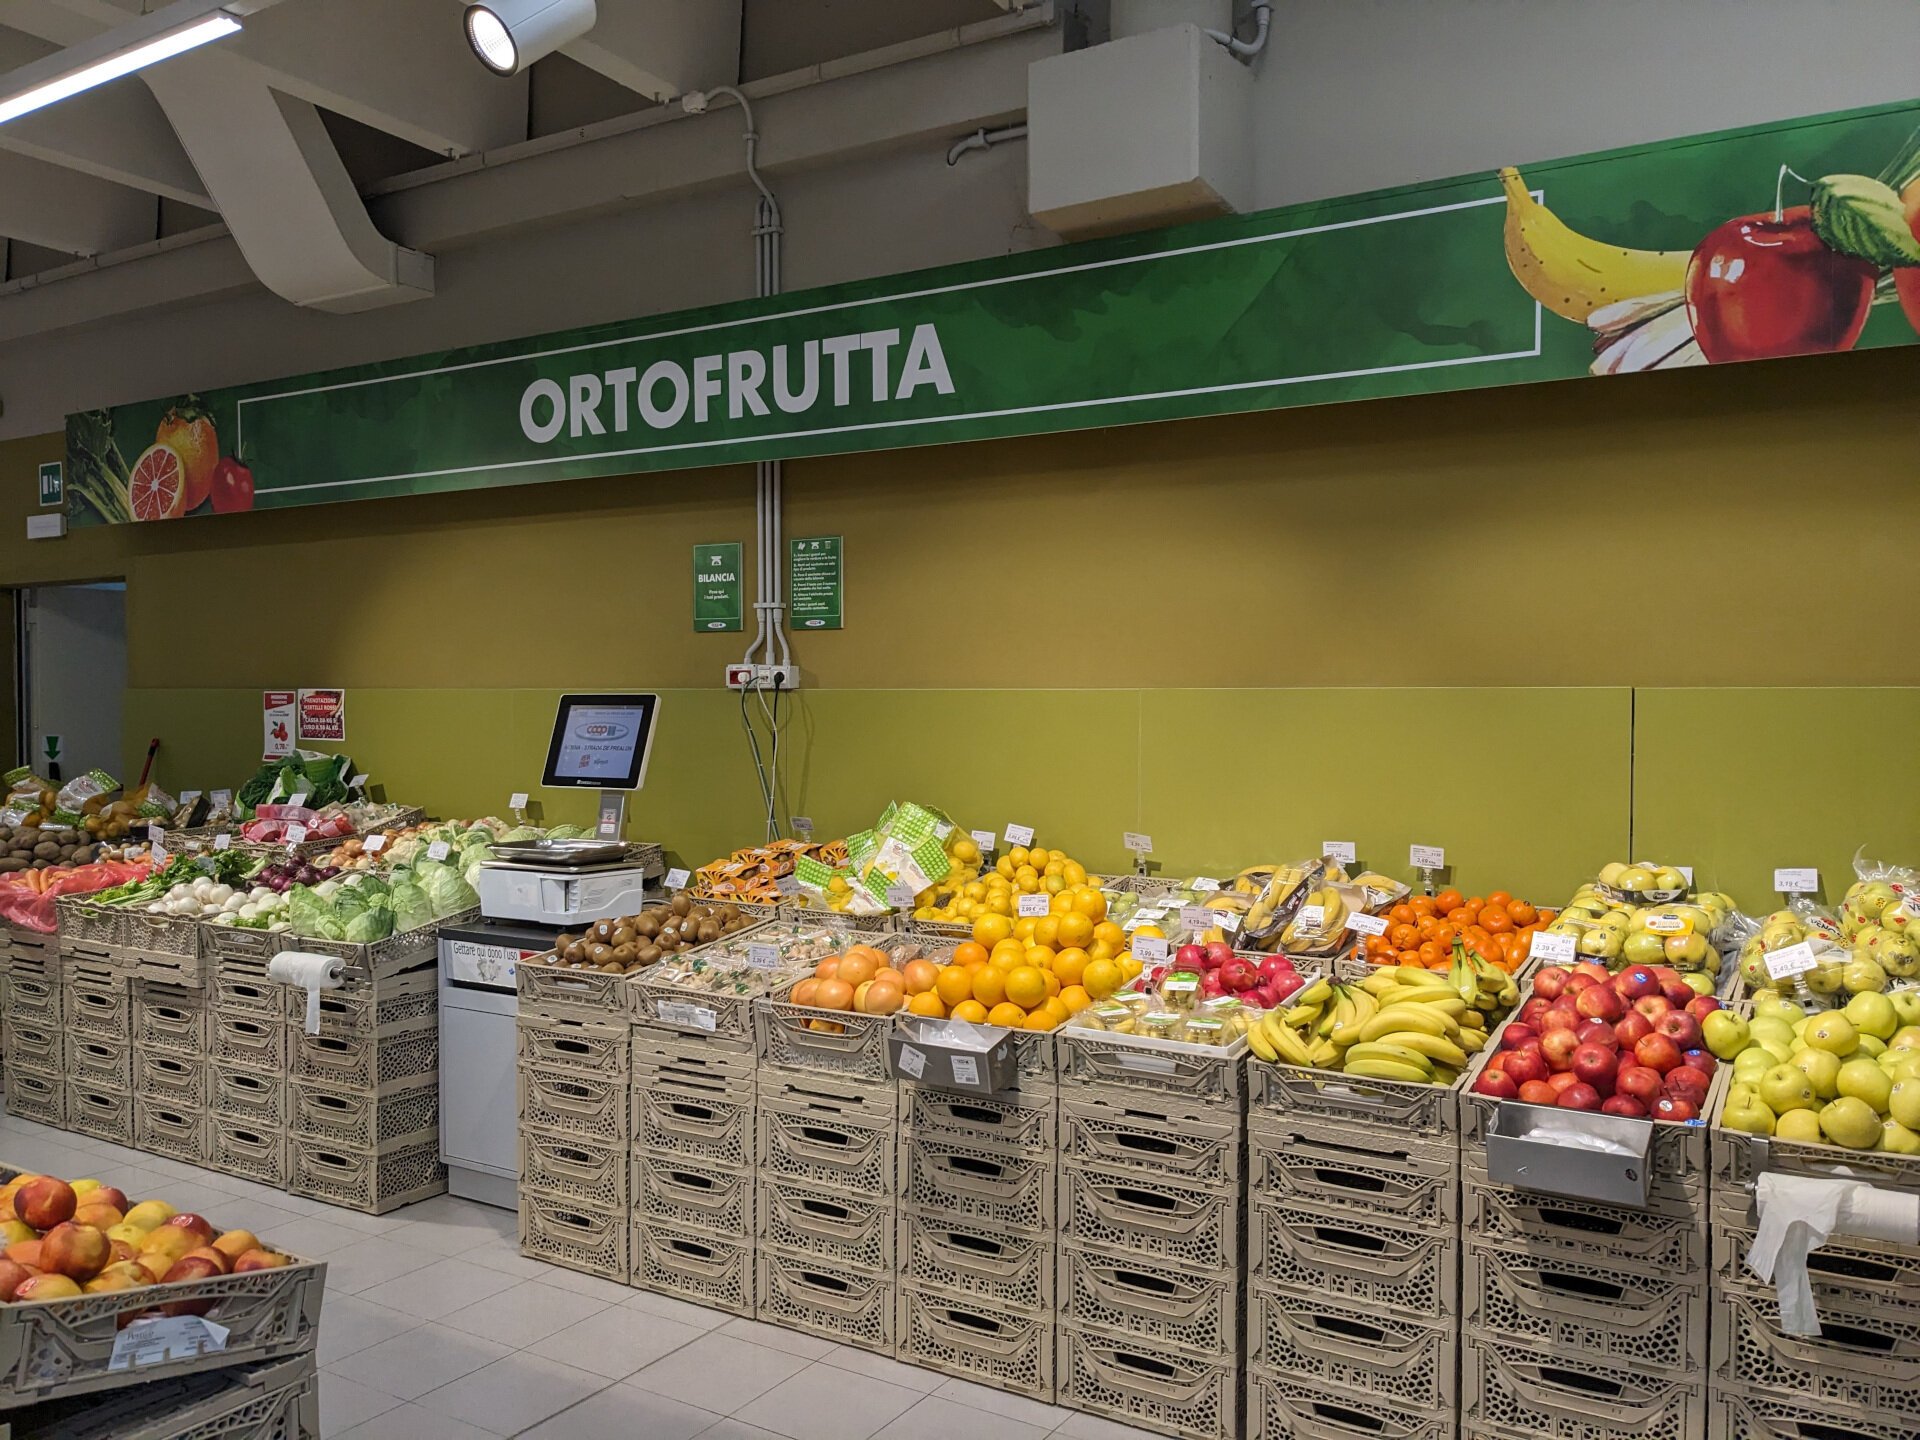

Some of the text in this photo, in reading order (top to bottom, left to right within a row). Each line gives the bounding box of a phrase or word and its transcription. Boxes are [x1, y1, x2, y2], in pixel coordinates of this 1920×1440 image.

[519, 323, 955, 443] ORTOFRUTTA
[698, 572, 735, 583] BILANCIA
[453, 943, 475, 956] Gettare
[477, 945, 487, 959] qui
[1773, 964, 1789, 975] 2,49
